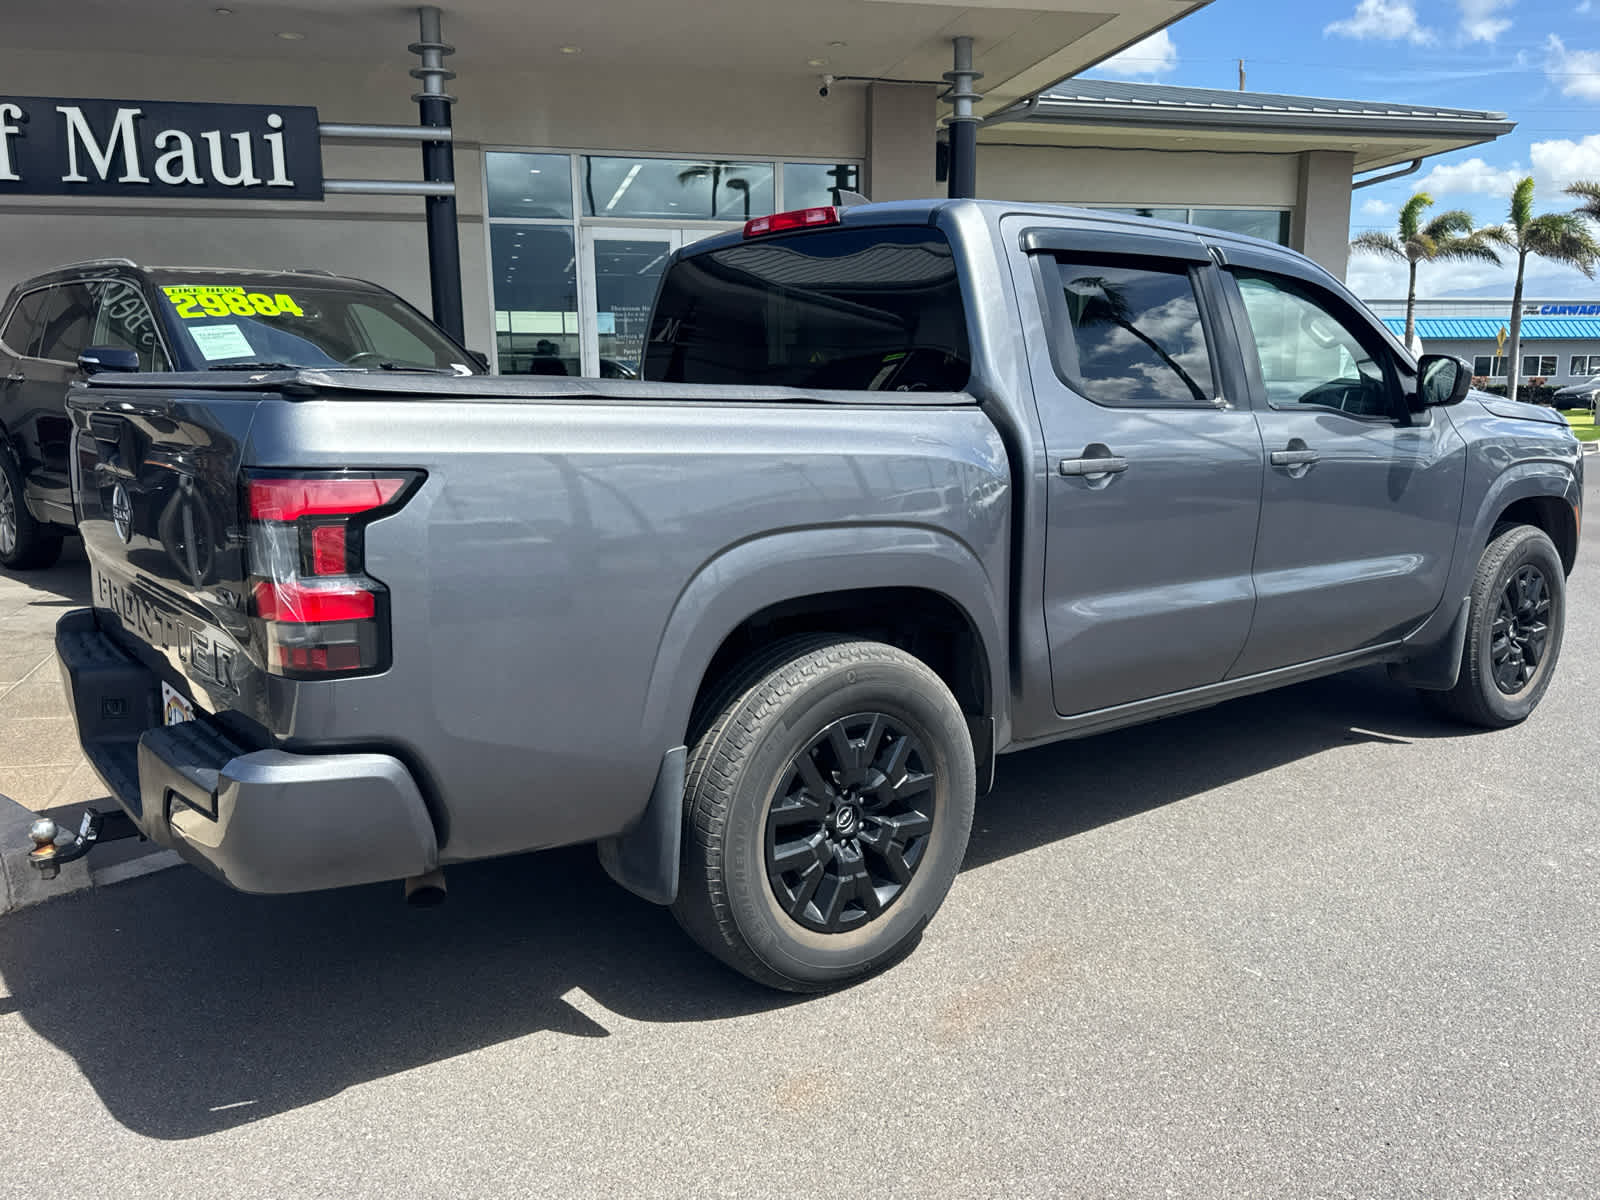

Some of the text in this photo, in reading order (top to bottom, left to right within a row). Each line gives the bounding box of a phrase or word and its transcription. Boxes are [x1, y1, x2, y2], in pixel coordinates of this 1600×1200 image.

[56, 106, 295, 187] Maui
[169, 293, 304, 319] 29884
[98, 571, 241, 697] FRONTIER
